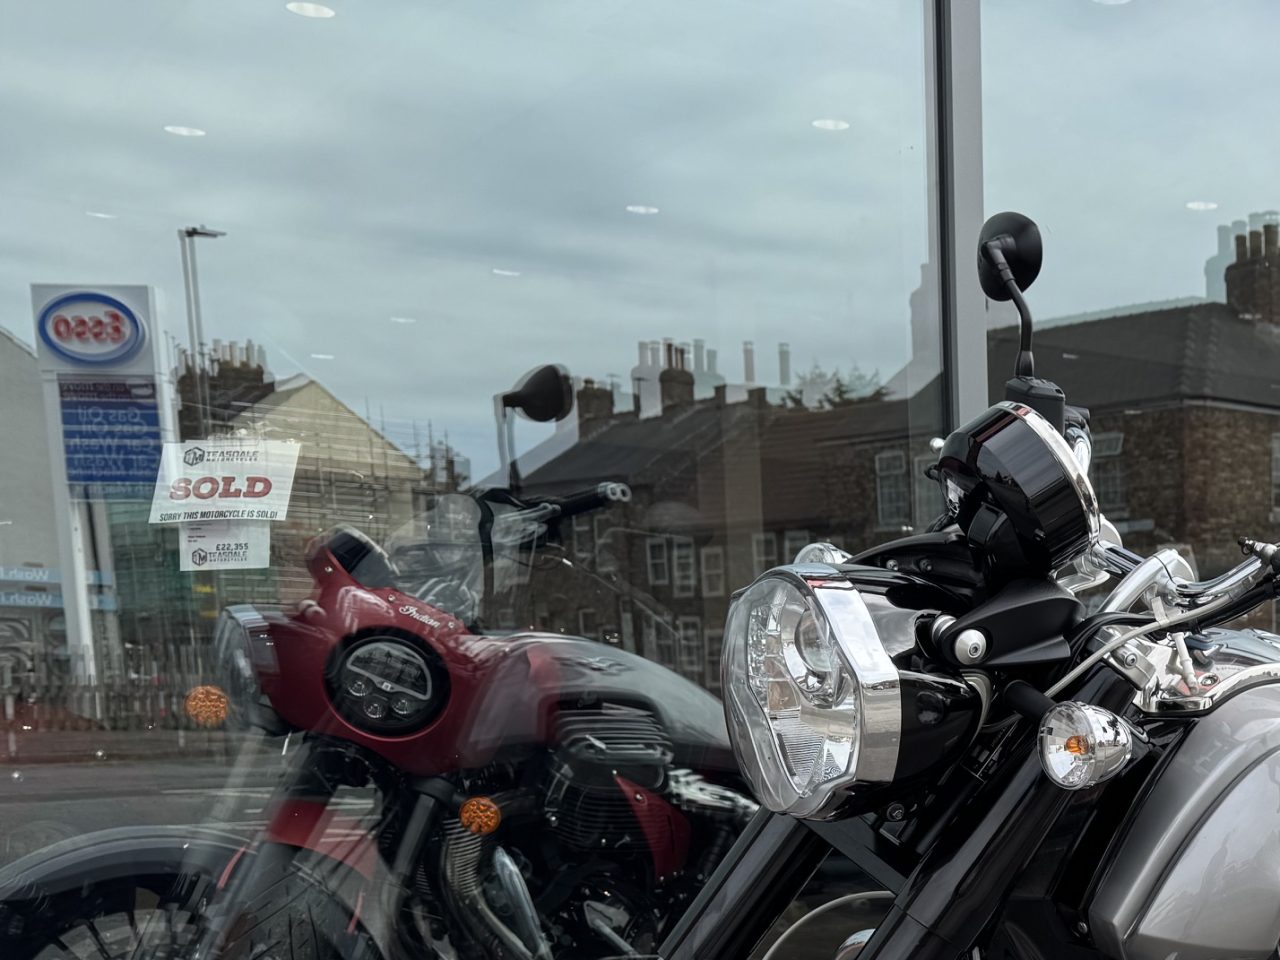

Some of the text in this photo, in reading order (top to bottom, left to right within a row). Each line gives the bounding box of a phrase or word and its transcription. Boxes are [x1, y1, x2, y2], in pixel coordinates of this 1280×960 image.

[169, 476, 272, 500] SOLD
[160, 510, 278, 521] SORRY THIS MOTORCYCLE IS SOLD!
[398, 605, 441, 628] Indian
